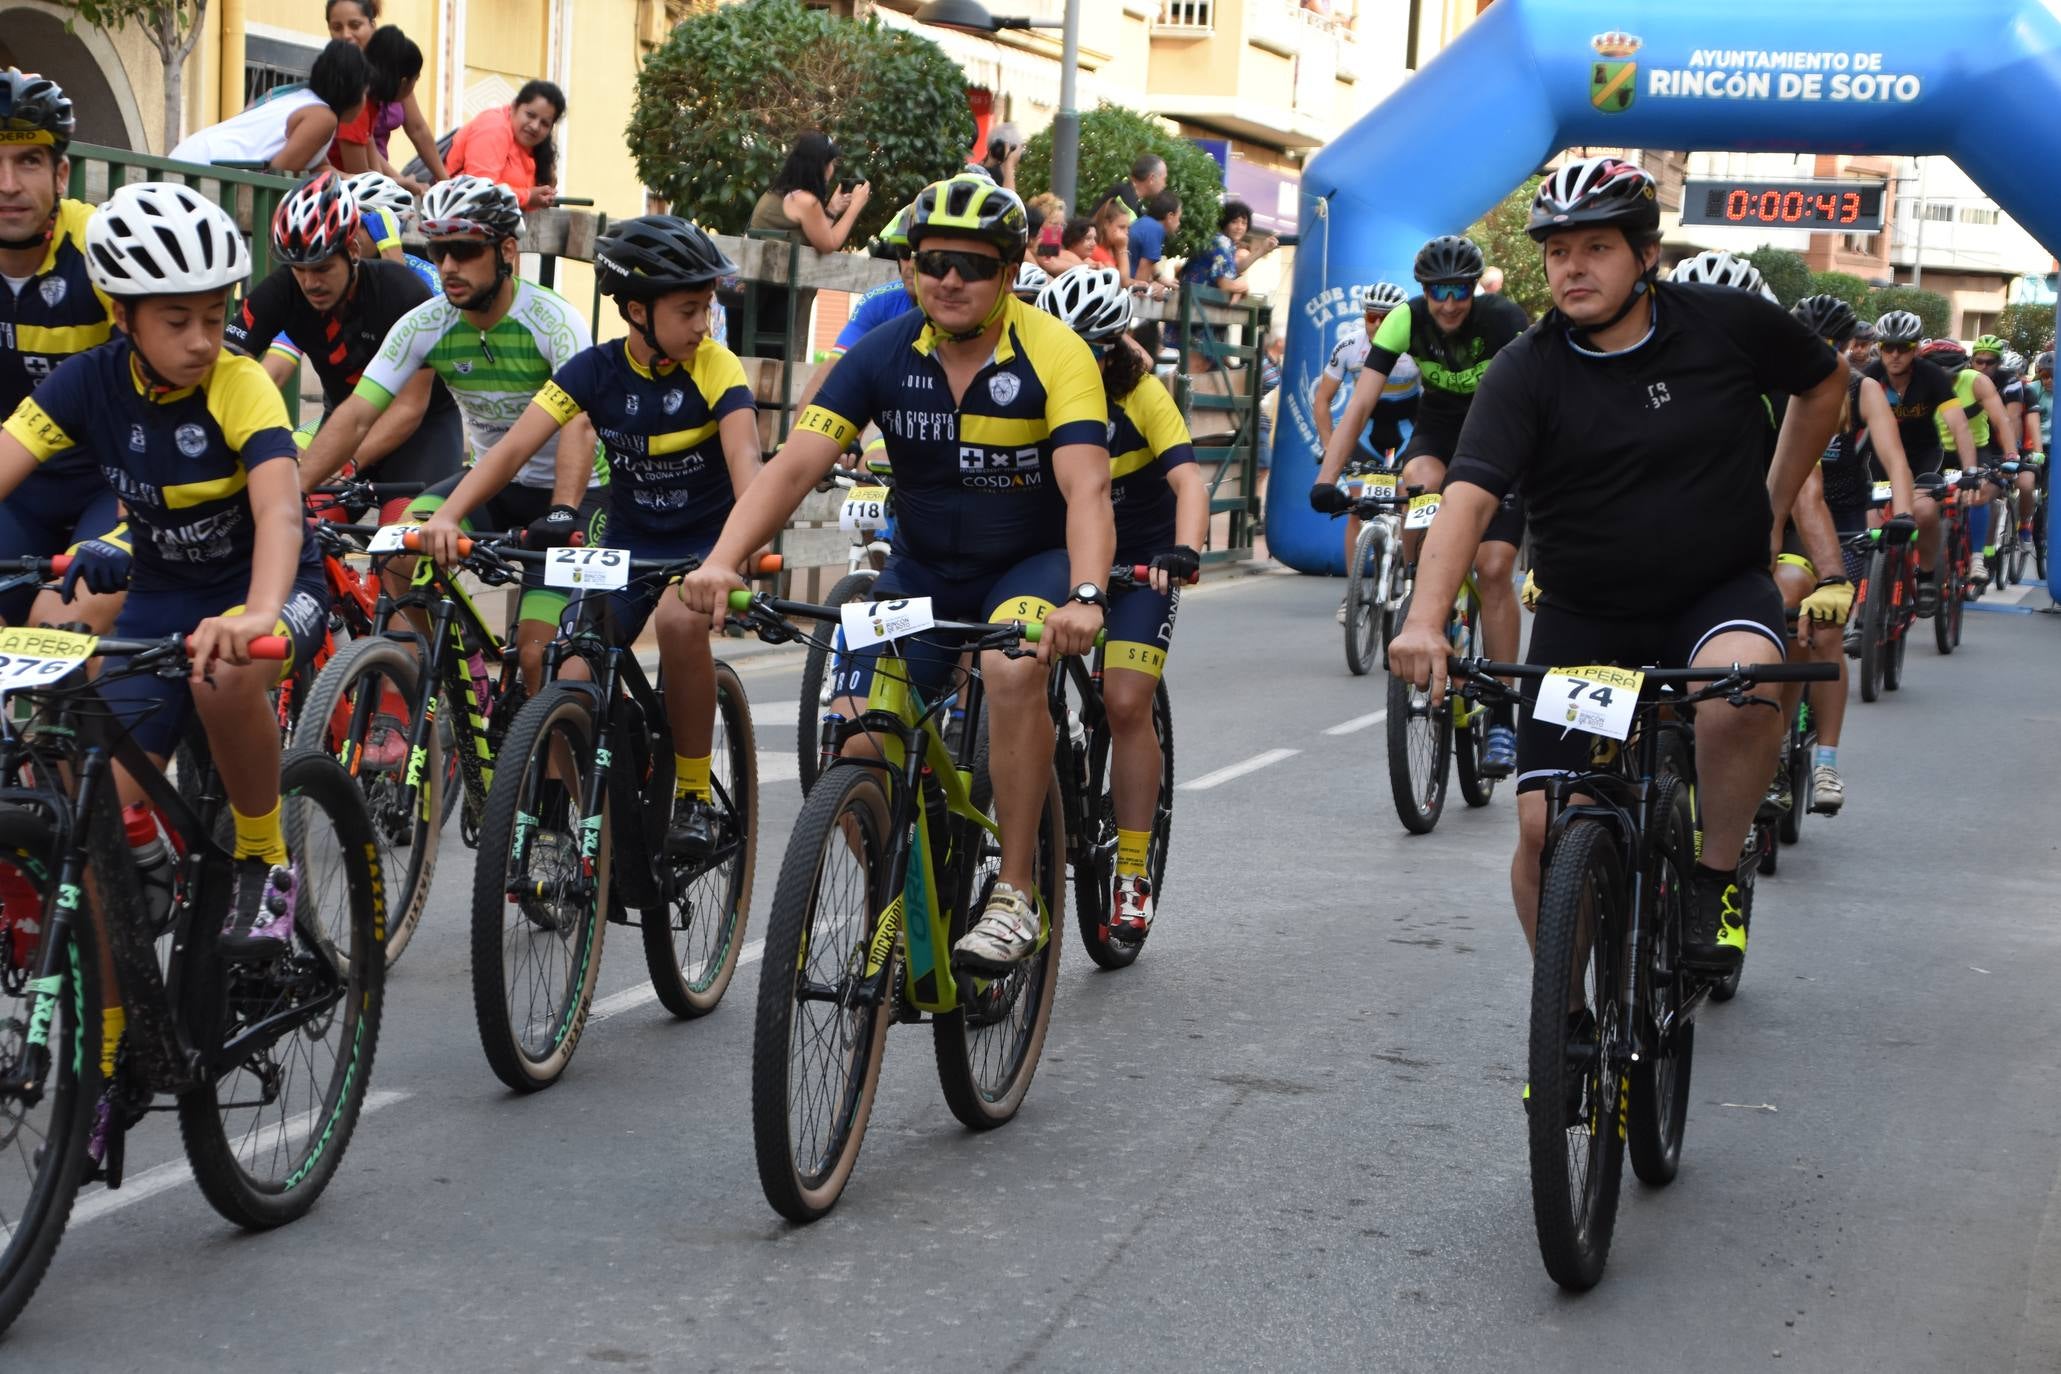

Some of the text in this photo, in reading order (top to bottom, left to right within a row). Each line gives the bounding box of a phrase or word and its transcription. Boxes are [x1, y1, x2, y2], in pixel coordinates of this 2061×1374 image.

[1689, 49, 1882, 71] AYUNTAMIENTO DE
[1650, 70, 1921, 101] RINCÓN DE SOTO
[1726, 189, 1860, 223] 0:00:43
[1305, 286, 1344, 316] CLUB
[1313, 303, 1333, 328] LA
[906, 410, 954, 424] CICLISTA
[962, 471, 1041, 489] COSDAM
[1367, 486, 1391, 497] 186
[848, 501, 879, 518] 118
[556, 548, 621, 567] 275
[24, 637, 86, 656] PERA
[1584, 668, 1636, 689] PERA
[1567, 678, 1614, 708] 74
